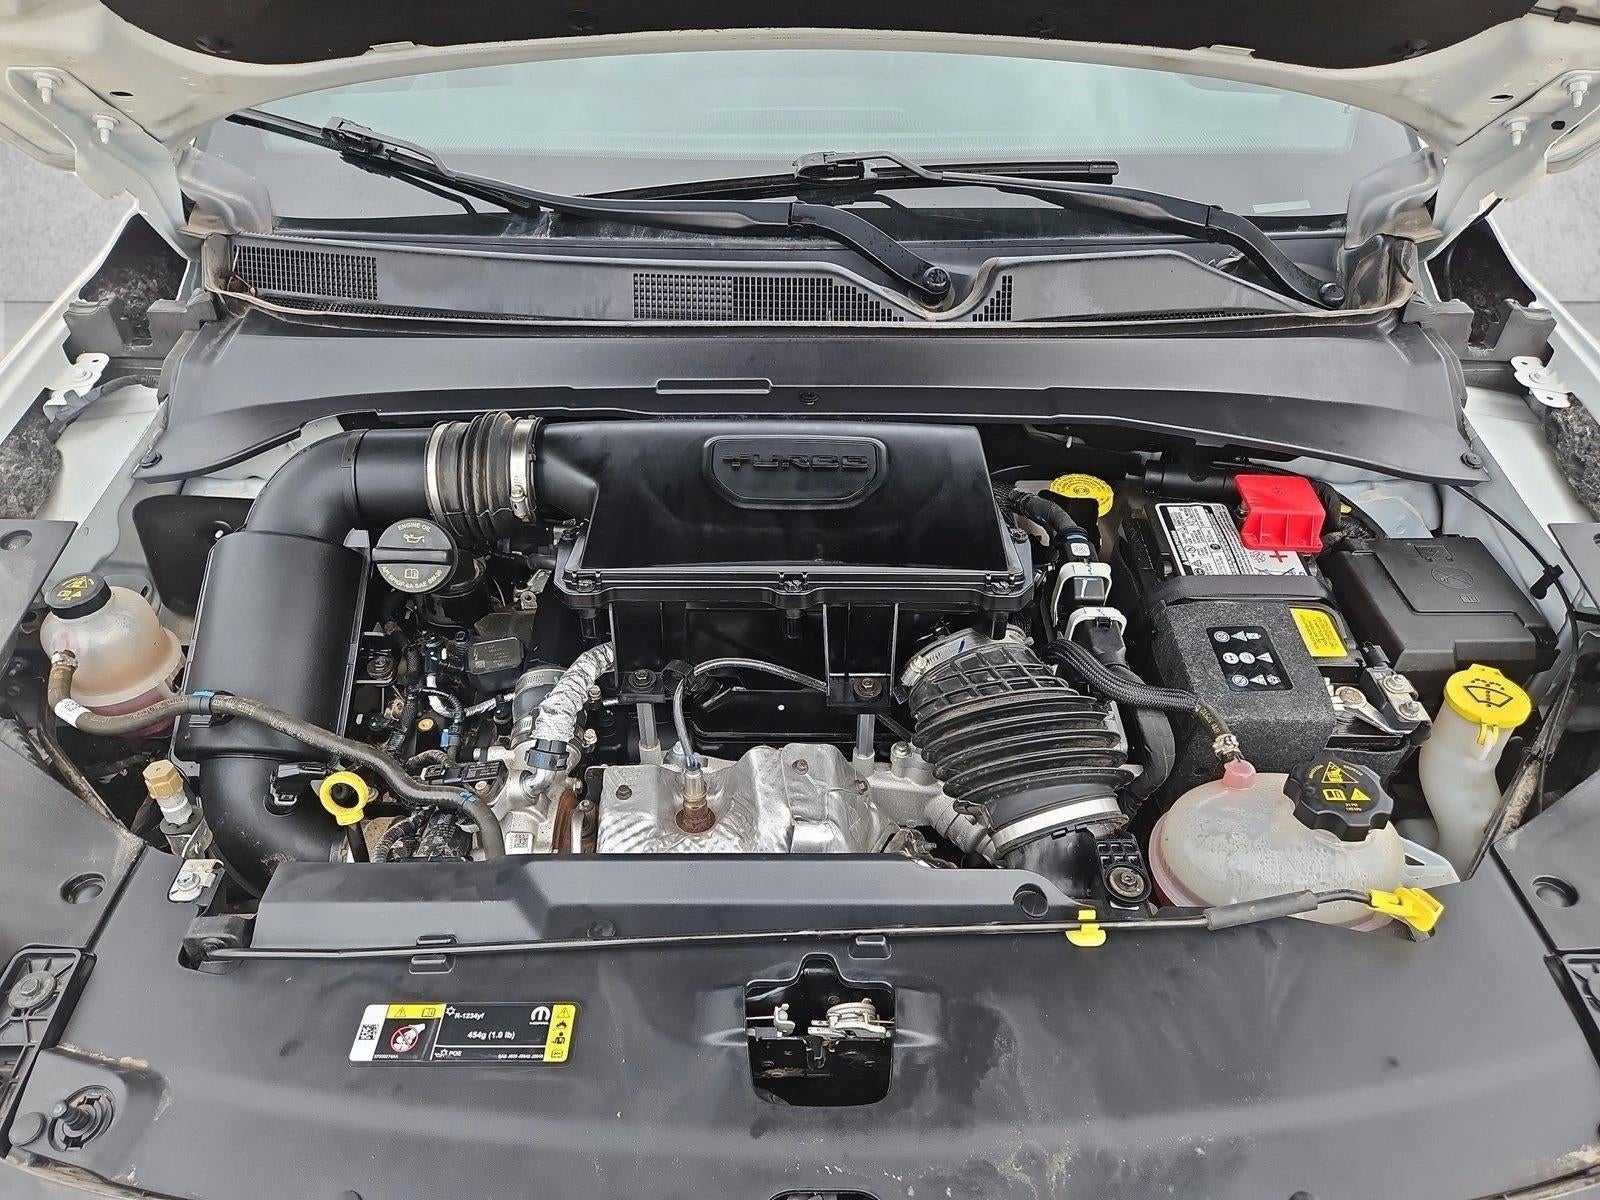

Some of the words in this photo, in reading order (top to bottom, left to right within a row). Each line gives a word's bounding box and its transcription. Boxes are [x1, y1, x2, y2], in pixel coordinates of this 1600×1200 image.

[722, 453, 869, 470] TURBO
[398, 522, 421, 531] ENGINE
[421, 524, 431, 533] OIL
[454, 1012, 485, 1021] R-1234yf
[467, 1031, 487, 1040] 454g
[488, 1031, 504, 1040] (1.0
[504, 1031, 516, 1040] lb)
